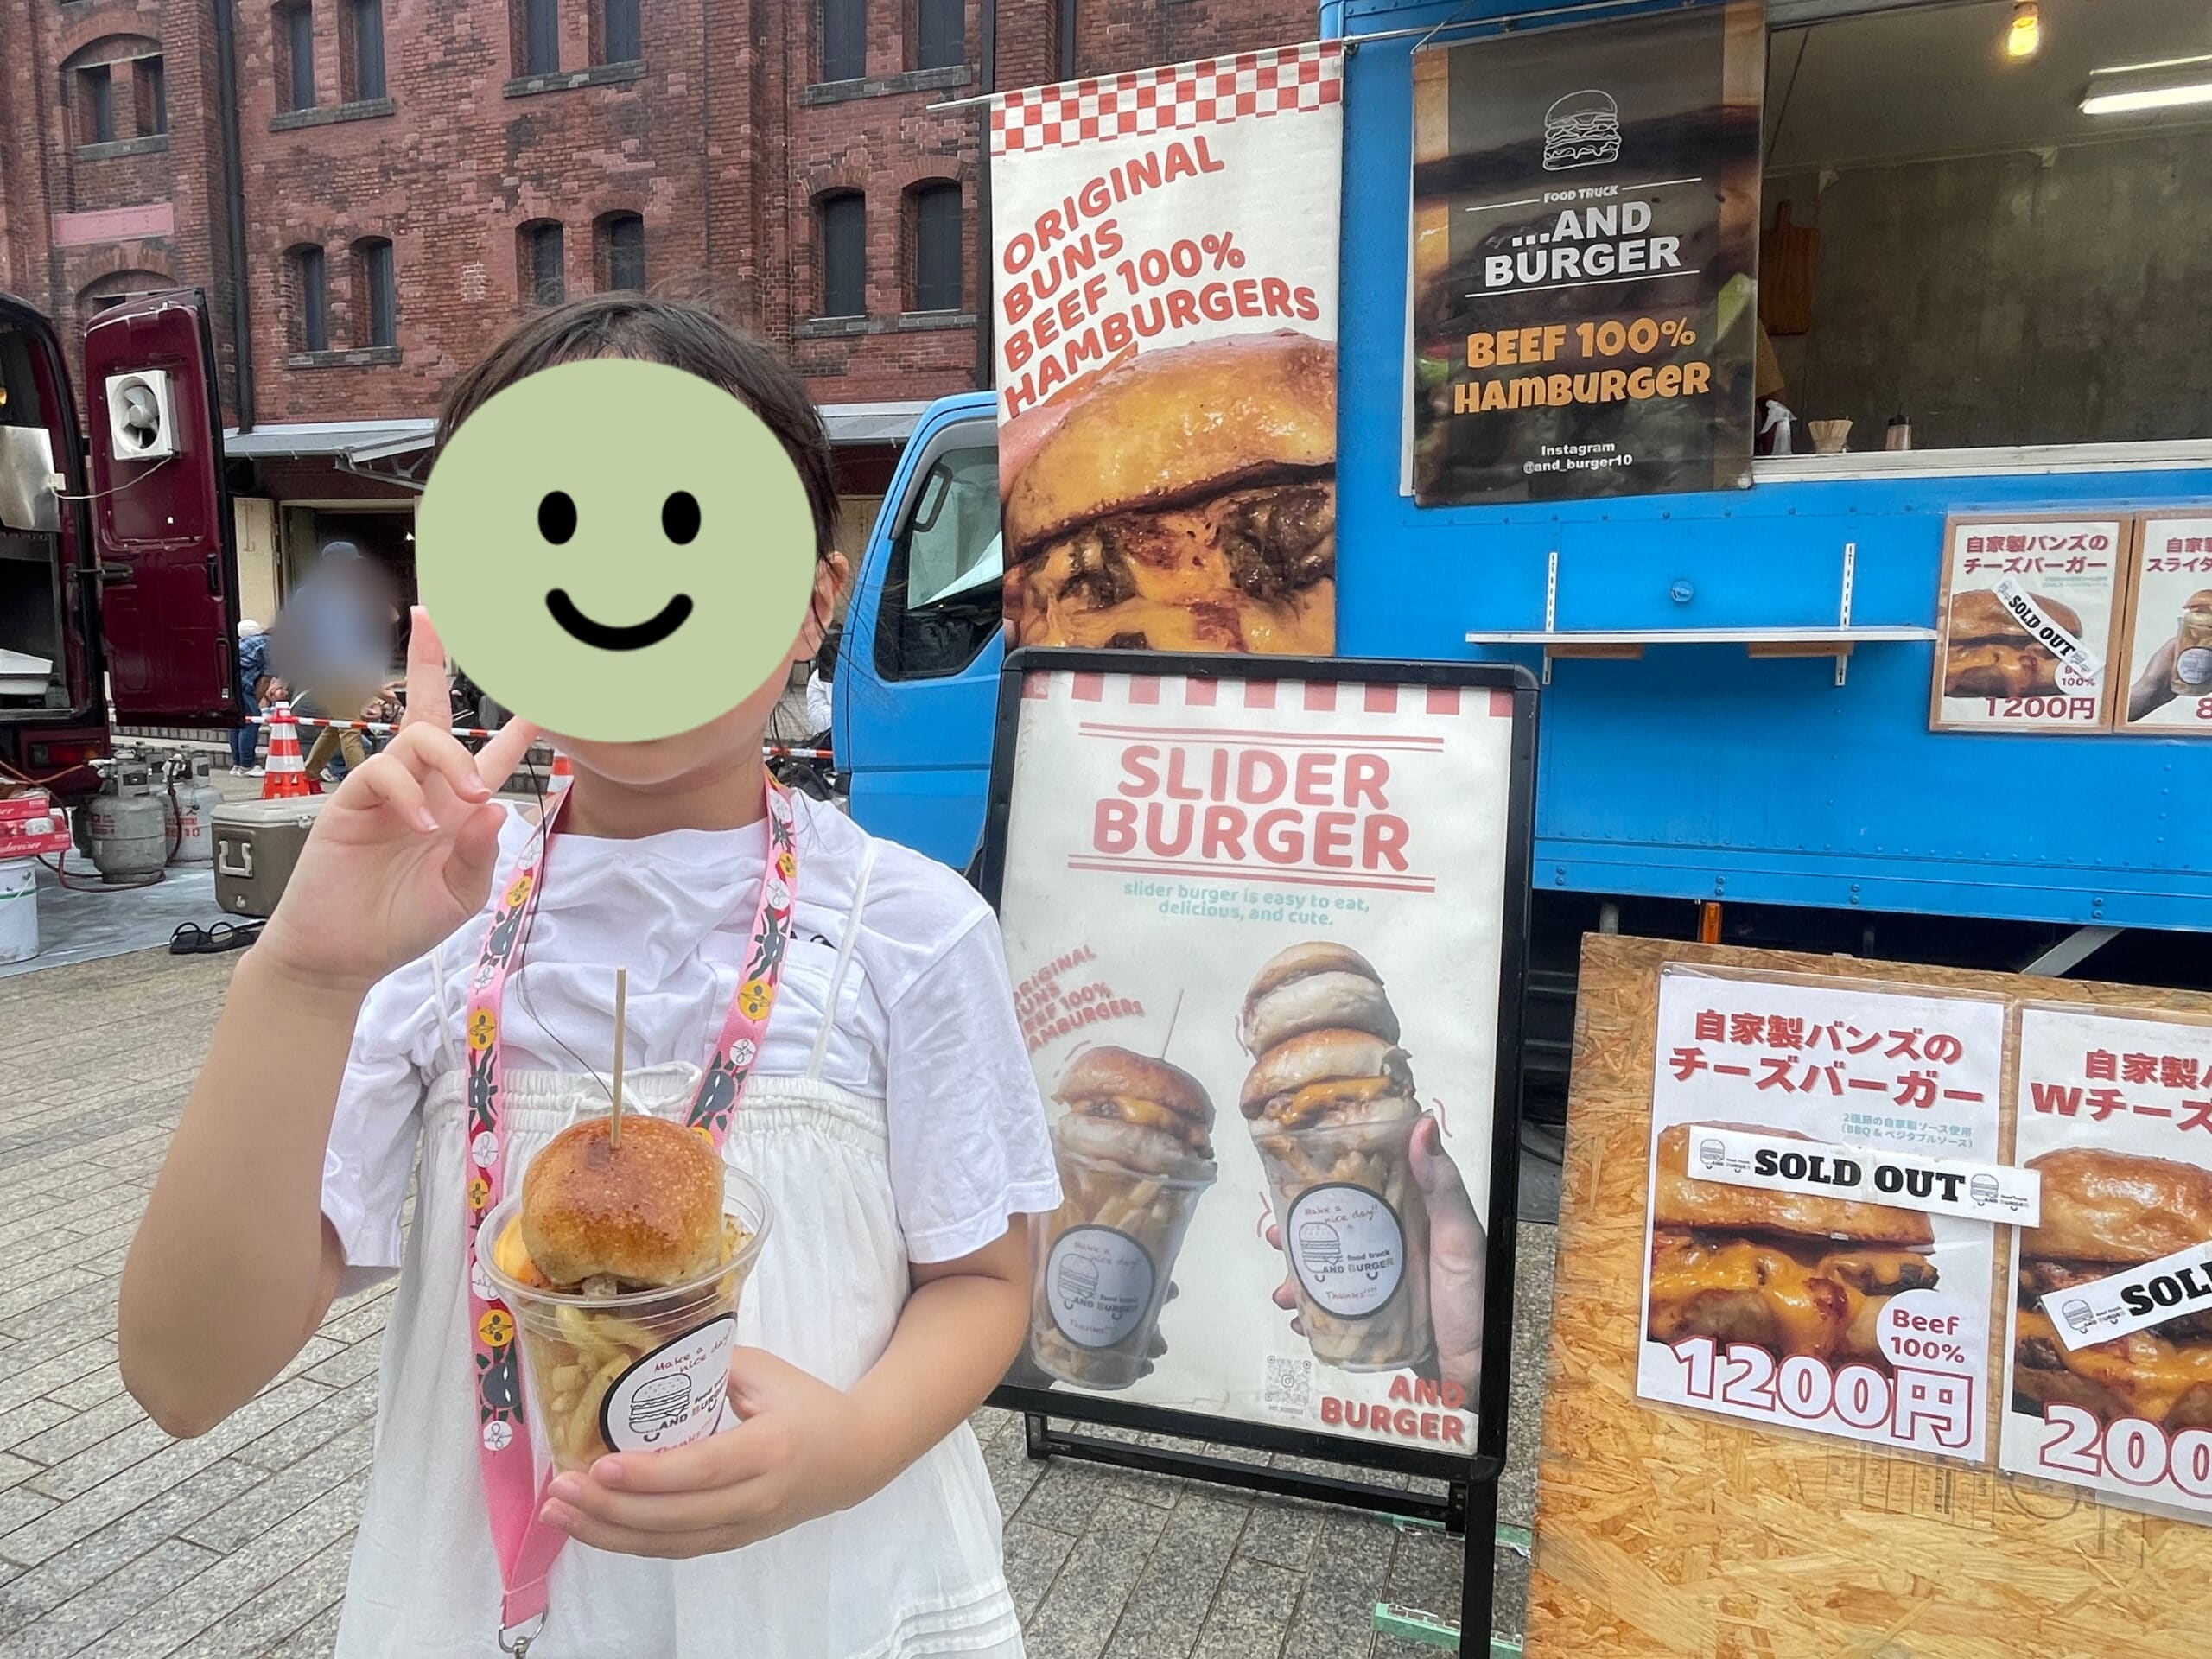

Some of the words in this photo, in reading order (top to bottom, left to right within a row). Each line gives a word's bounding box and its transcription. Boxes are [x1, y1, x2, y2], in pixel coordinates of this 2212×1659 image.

[1003, 136, 1224, 274] ORIGINAL
[1544, 190, 1576, 203] FOOD
[1579, 185, 1618, 199] TRUCK
[1003, 219, 1123, 325] BUNS
[1485, 236, 1681, 289] BURGER
[1004, 273, 1107, 372] BEEF
[1116, 231, 1245, 295] 100%
[1467, 325, 1567, 369] BEEF
[1576, 317, 1696, 358] 100%
[1523, 454, 1632, 474] @and_burger10
[1541, 443, 1615, 456] Instagram
[1964, 557, 2107, 574] チーズバーガー
[1967, 535, 2108, 553] 自家製バンズの
[2009, 595, 2040, 628] SOLD
[2039, 627, 2076, 656] OUT
[1986, 696, 2095, 719] 1200円
[1118, 745, 1389, 810] SLIDER
[1093, 798, 1409, 871] BURGER
[1123, 880, 1173, 897] slider
[1178, 885, 1237, 903] burger
[1243, 887, 1258, 902] is
[1263, 892, 1306, 908] easy
[1310, 893, 1329, 907] to
[1335, 897, 1370, 912] eat,
[1159, 900, 1244, 921] delicious,
[1249, 907, 1283, 922] and
[1288, 912, 1333, 925] cute.
[1028, 998, 1145, 1052] AMBURGERS
[1695, 1009, 1962, 1064] 自家製バンズの
[1669, 1046, 1985, 1109] チーズバーガー
[1755, 1149, 1862, 1187] SOLD
[1875, 1166, 1966, 1202] OUT
[1348, 1258, 1395, 1273] BURGER
[1892, 1308, 1959, 1335] Beef
[654, 1354, 690, 1374] Make
[1891, 1336, 1965, 1363] 100%
[1388, 1375, 1466, 1410] AND
[1669, 1336, 1974, 1449] 1200円
[1320, 1396, 1465, 1445] BURGER
